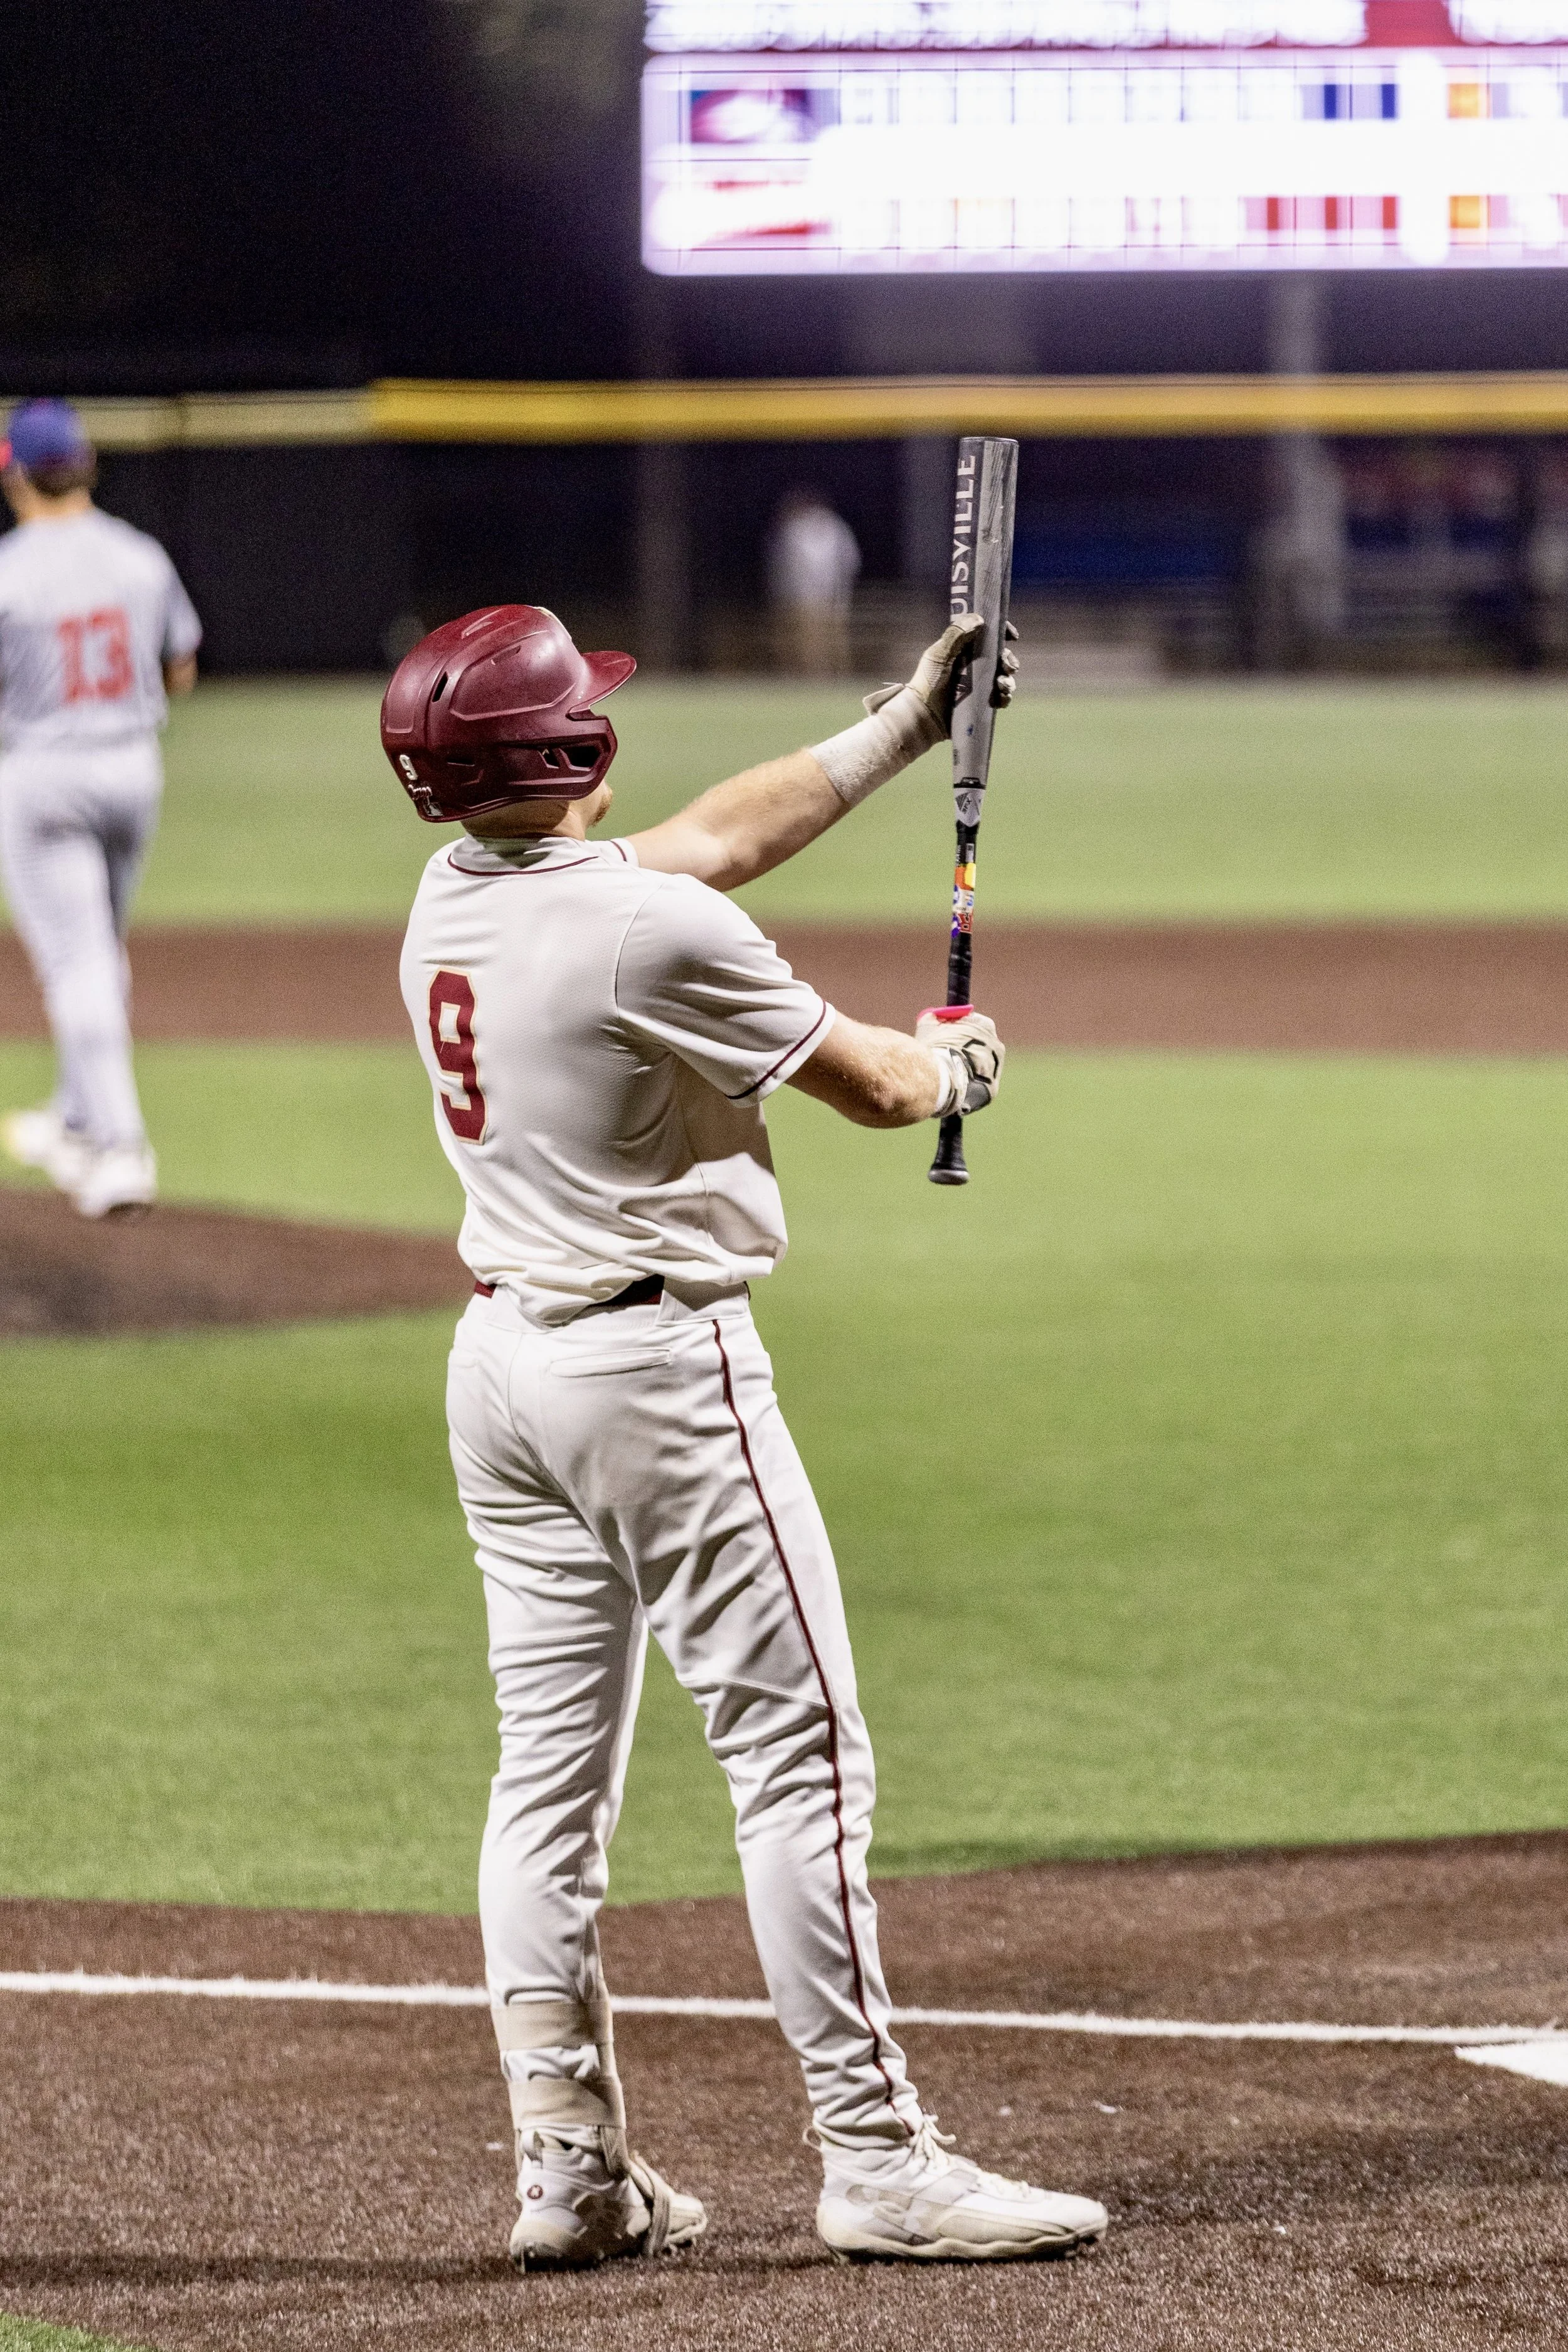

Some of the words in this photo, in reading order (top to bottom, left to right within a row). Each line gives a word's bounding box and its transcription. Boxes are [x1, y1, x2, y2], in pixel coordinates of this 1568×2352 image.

[950, 455, 975, 665] UISVILLE
[58, 606, 134, 705] 13
[399, 755, 418, 780] 9
[427, 965, 489, 1146] 9
